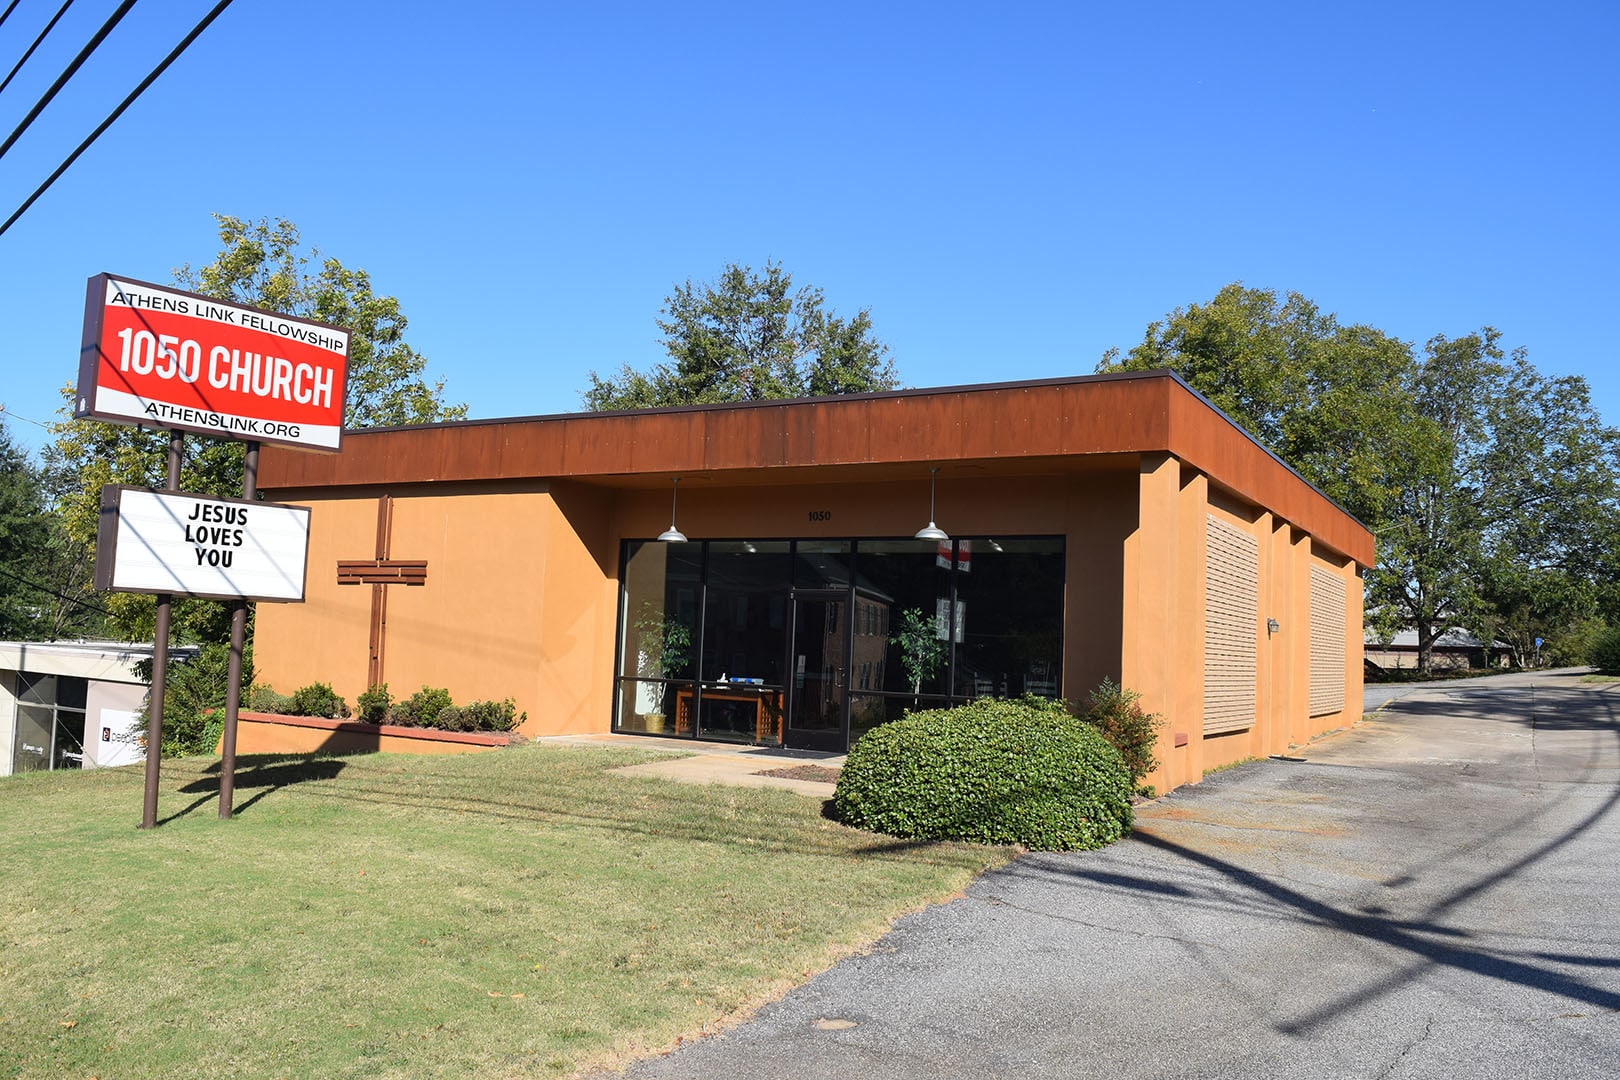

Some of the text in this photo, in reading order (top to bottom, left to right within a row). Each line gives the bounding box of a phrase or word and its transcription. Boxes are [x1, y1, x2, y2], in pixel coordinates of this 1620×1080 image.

[112, 292, 344, 351] ATHENS LINK FELLOWSHIP
[118, 327, 333, 409] 1050 CHURCH
[145, 402, 301, 438] ATHENSLINK.ORG
[188, 503, 248, 525] JESUS
[808, 511, 831, 521] 1050
[185, 524, 243, 547] LOVES
[195, 548, 233, 568] YOU
